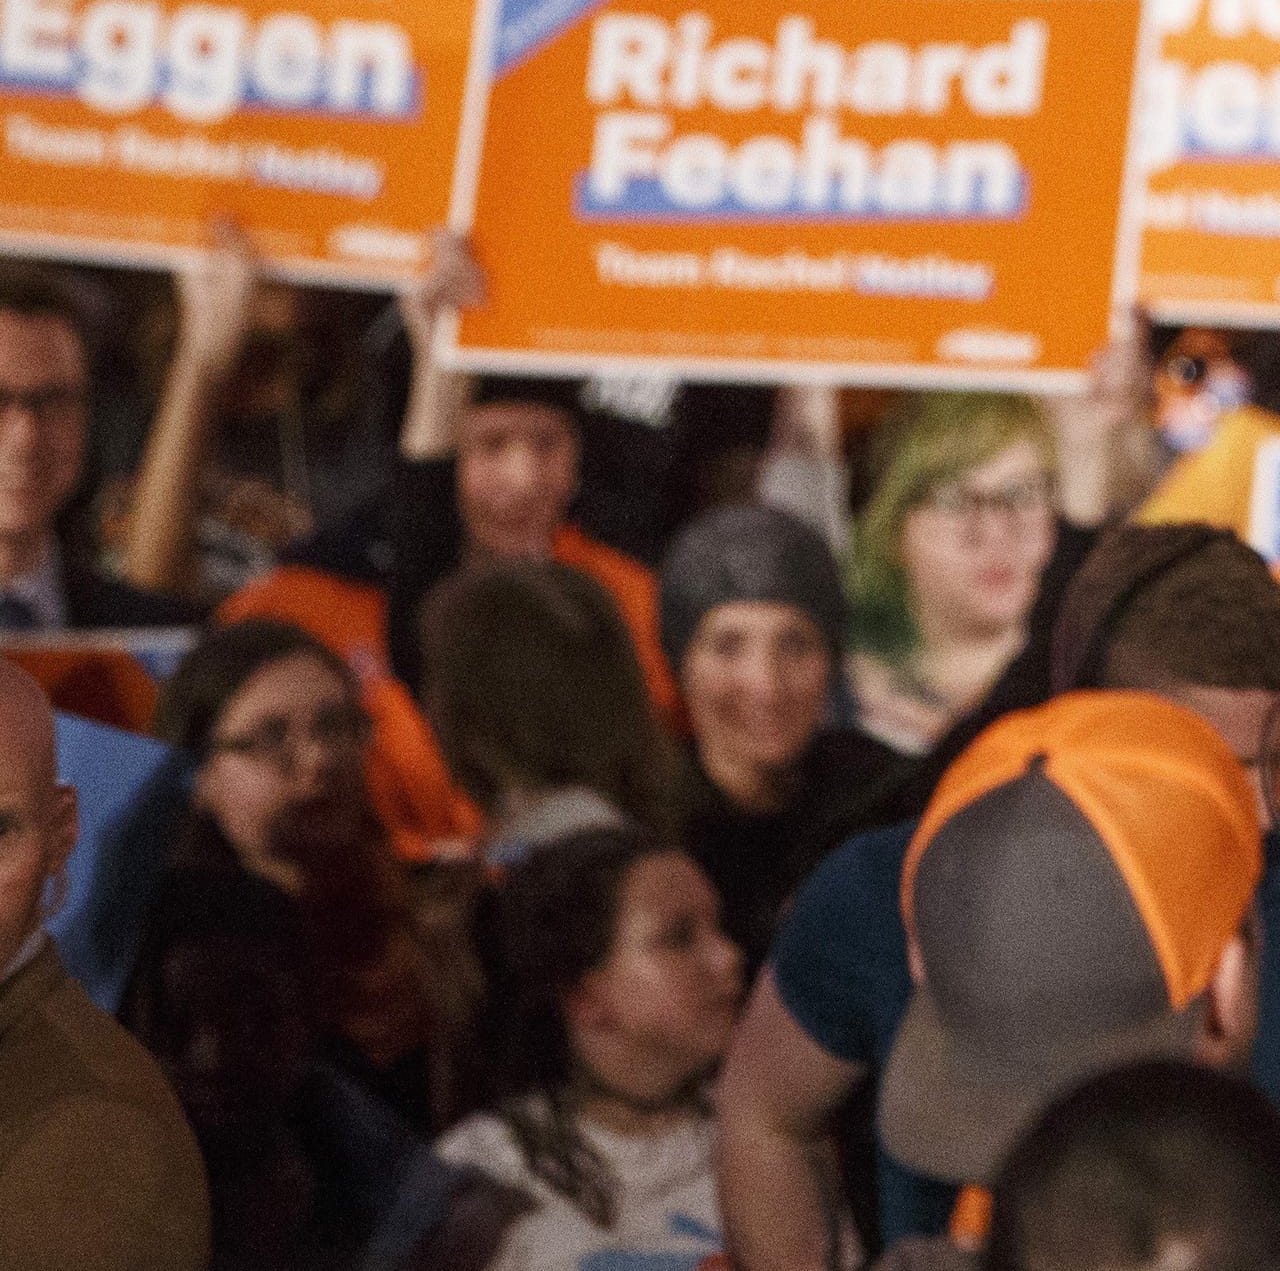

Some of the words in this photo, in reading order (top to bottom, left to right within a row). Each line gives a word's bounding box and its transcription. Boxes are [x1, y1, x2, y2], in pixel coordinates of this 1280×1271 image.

[587, 10, 1050, 118] Richard
[585, 111, 1022, 214] Feehan
[708, 245, 846, 292] Rachel
